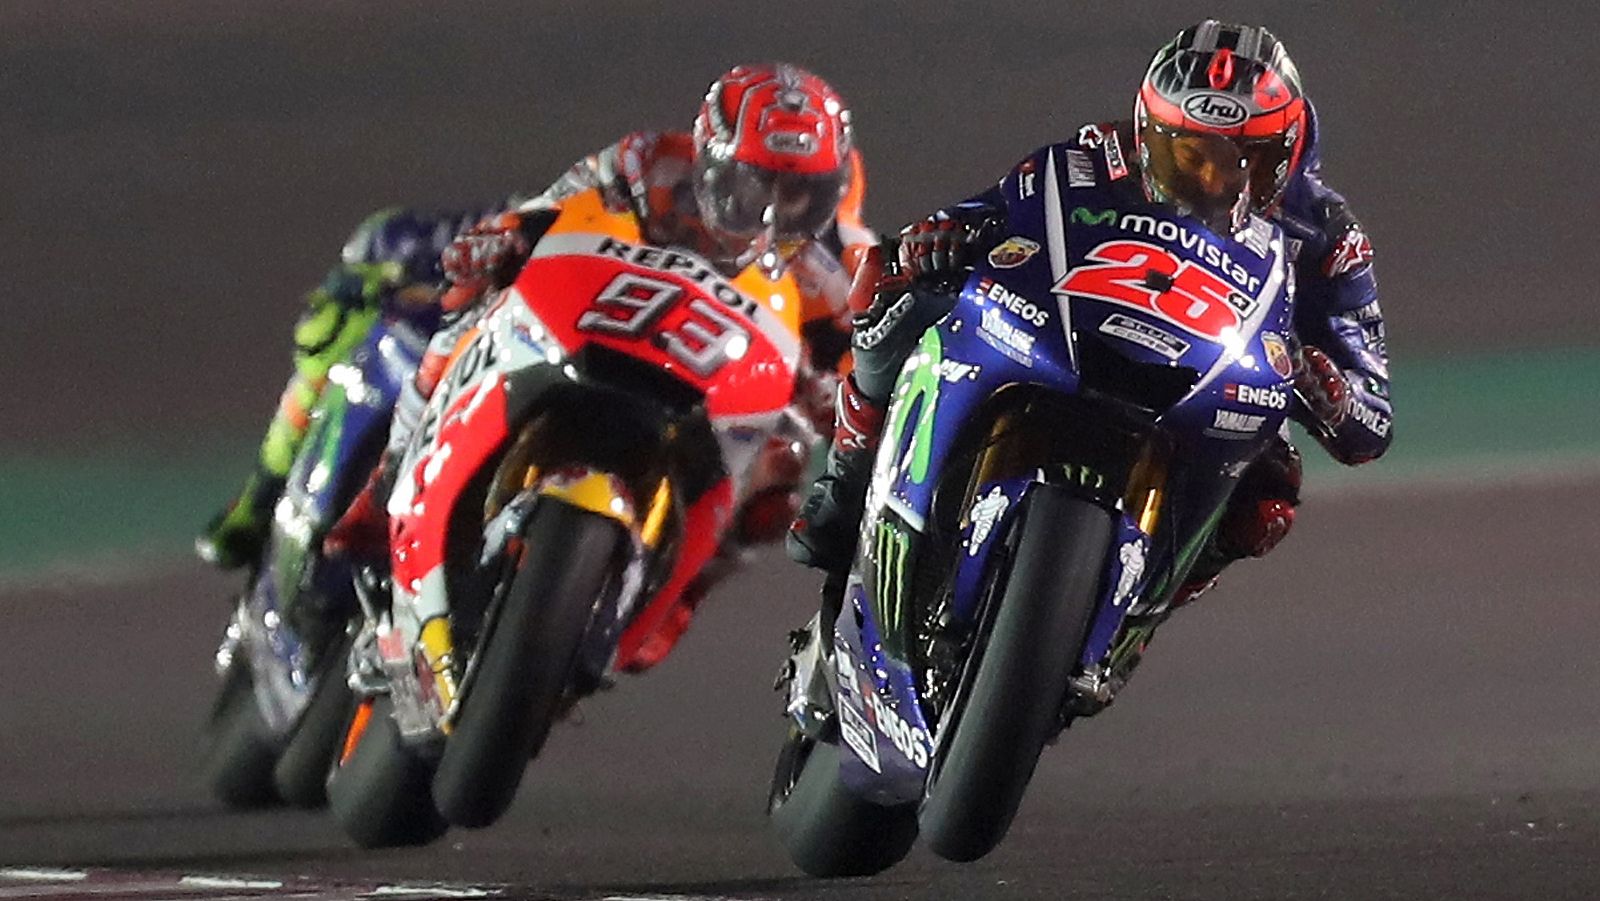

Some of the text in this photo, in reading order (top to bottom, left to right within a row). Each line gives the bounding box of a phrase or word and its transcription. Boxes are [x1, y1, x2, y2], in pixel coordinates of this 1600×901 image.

[1189, 96, 1239, 118] Arai
[1120, 213, 1261, 293] movistar
[577, 272, 752, 379] 93
[988, 283, 1049, 327] ENEOS
[1050, 240, 1244, 345] 25
[1238, 385, 1287, 409] ENEOS
[872, 692, 928, 768] ENEOS
